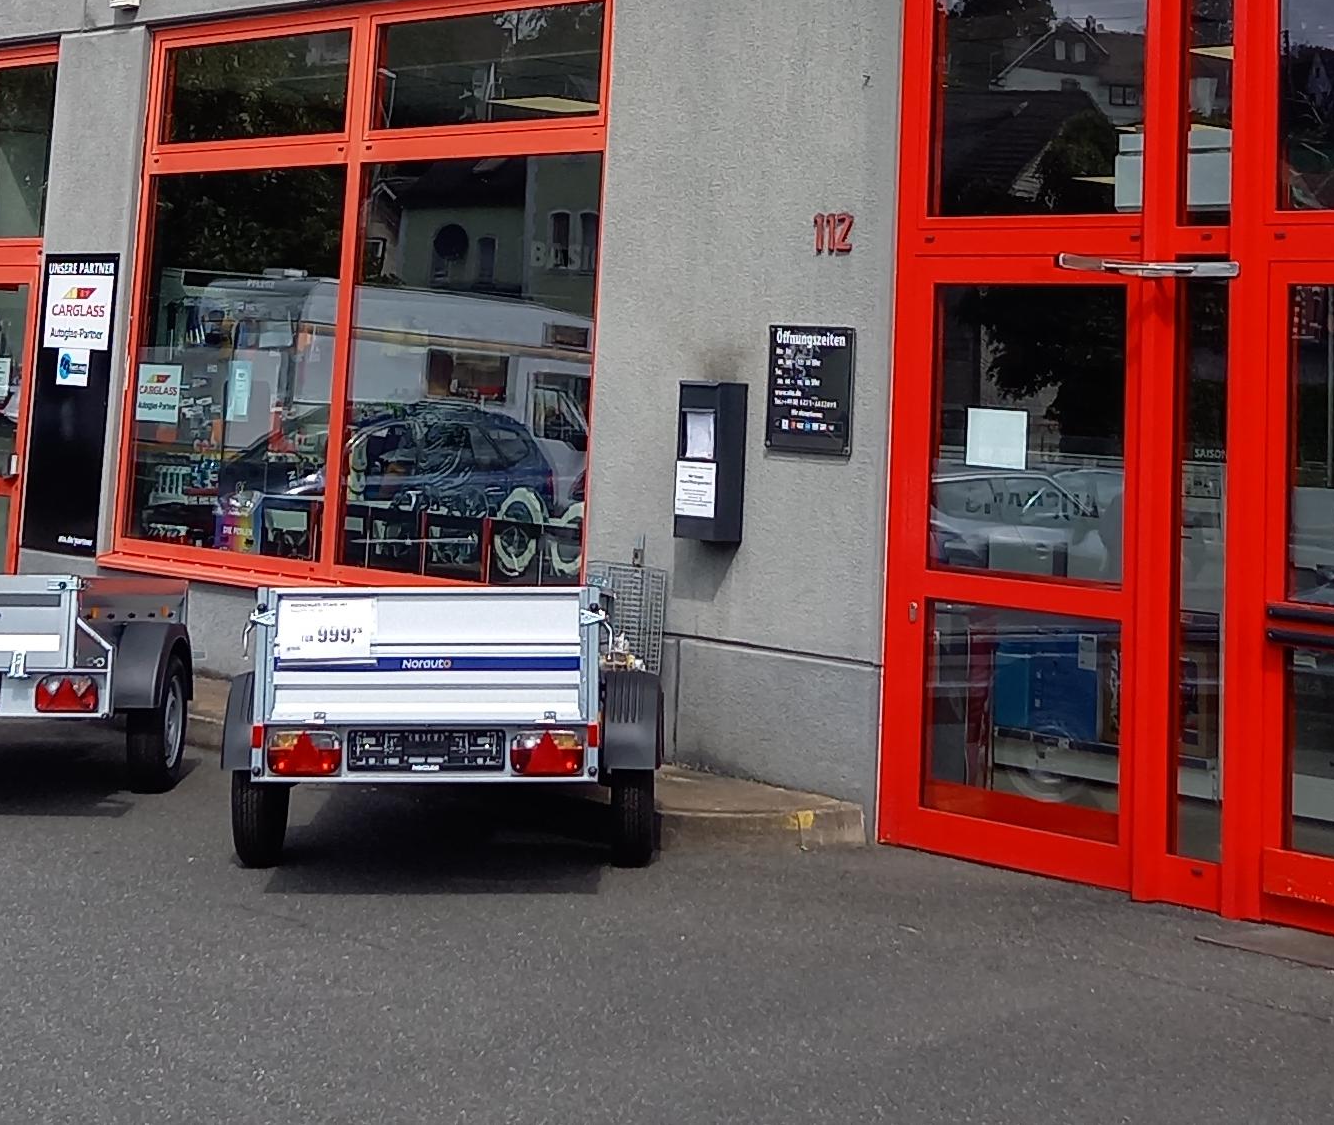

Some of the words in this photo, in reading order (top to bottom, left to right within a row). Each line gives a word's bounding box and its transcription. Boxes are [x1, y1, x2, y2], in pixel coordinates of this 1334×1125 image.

[813, 212, 855, 256] 112
[49, 262, 78, 274] UNSERE
[79, 262, 114, 274] PARTNER
[52, 304, 105, 318] CARGLASS
[776, 327, 846, 348] Öffnungszeiten
[139, 385, 178, 396] CARGLASS
[401, 658, 452, 669] Norauto
